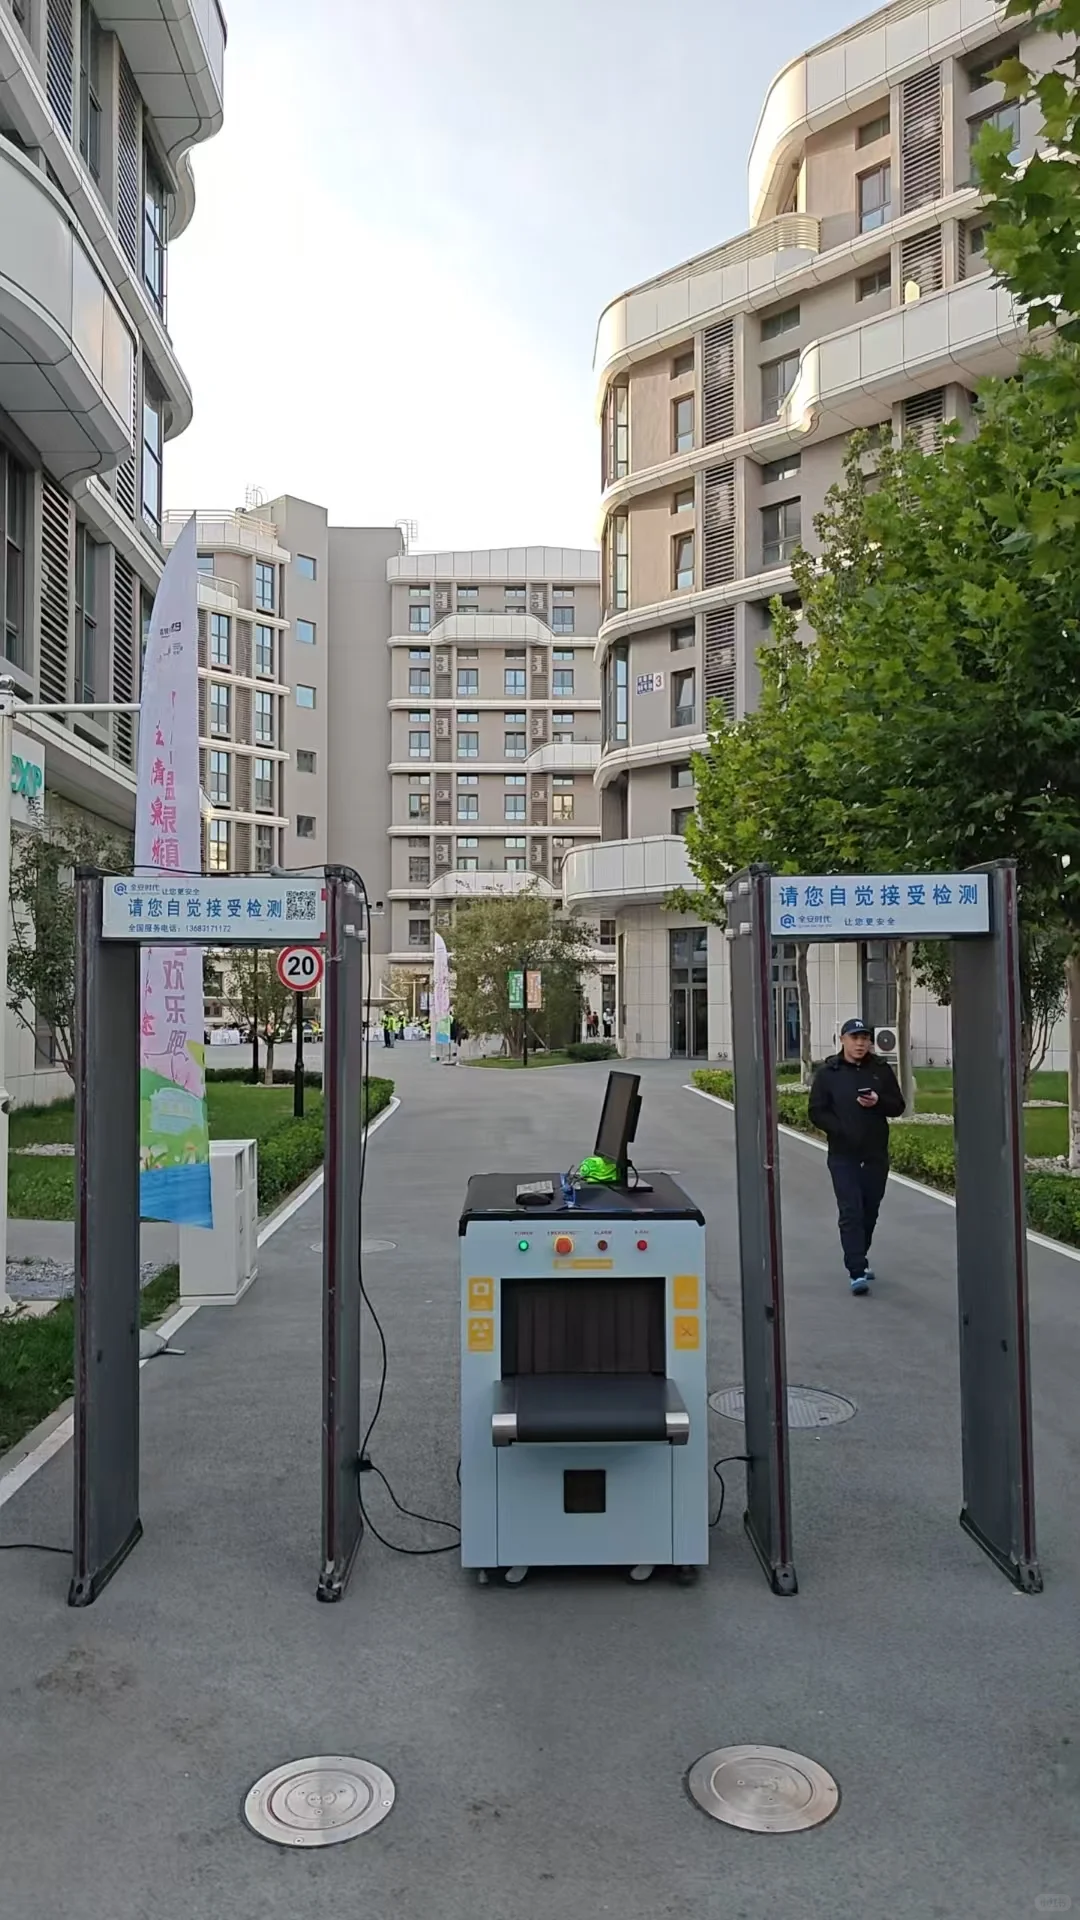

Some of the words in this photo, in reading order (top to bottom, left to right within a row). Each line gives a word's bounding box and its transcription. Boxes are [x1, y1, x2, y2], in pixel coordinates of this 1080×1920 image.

[655, 675, 662, 688] 3
[162, 887, 200, 896] 让您更安全
[779, 884, 978, 907] 请您自觉接受检测
[128, 897, 283, 918] 请您自觉接受检测
[844, 916, 896, 926] 让您更安全
[185, 924, 232, 933] 13683171172
[287, 956, 315, 976] 20
